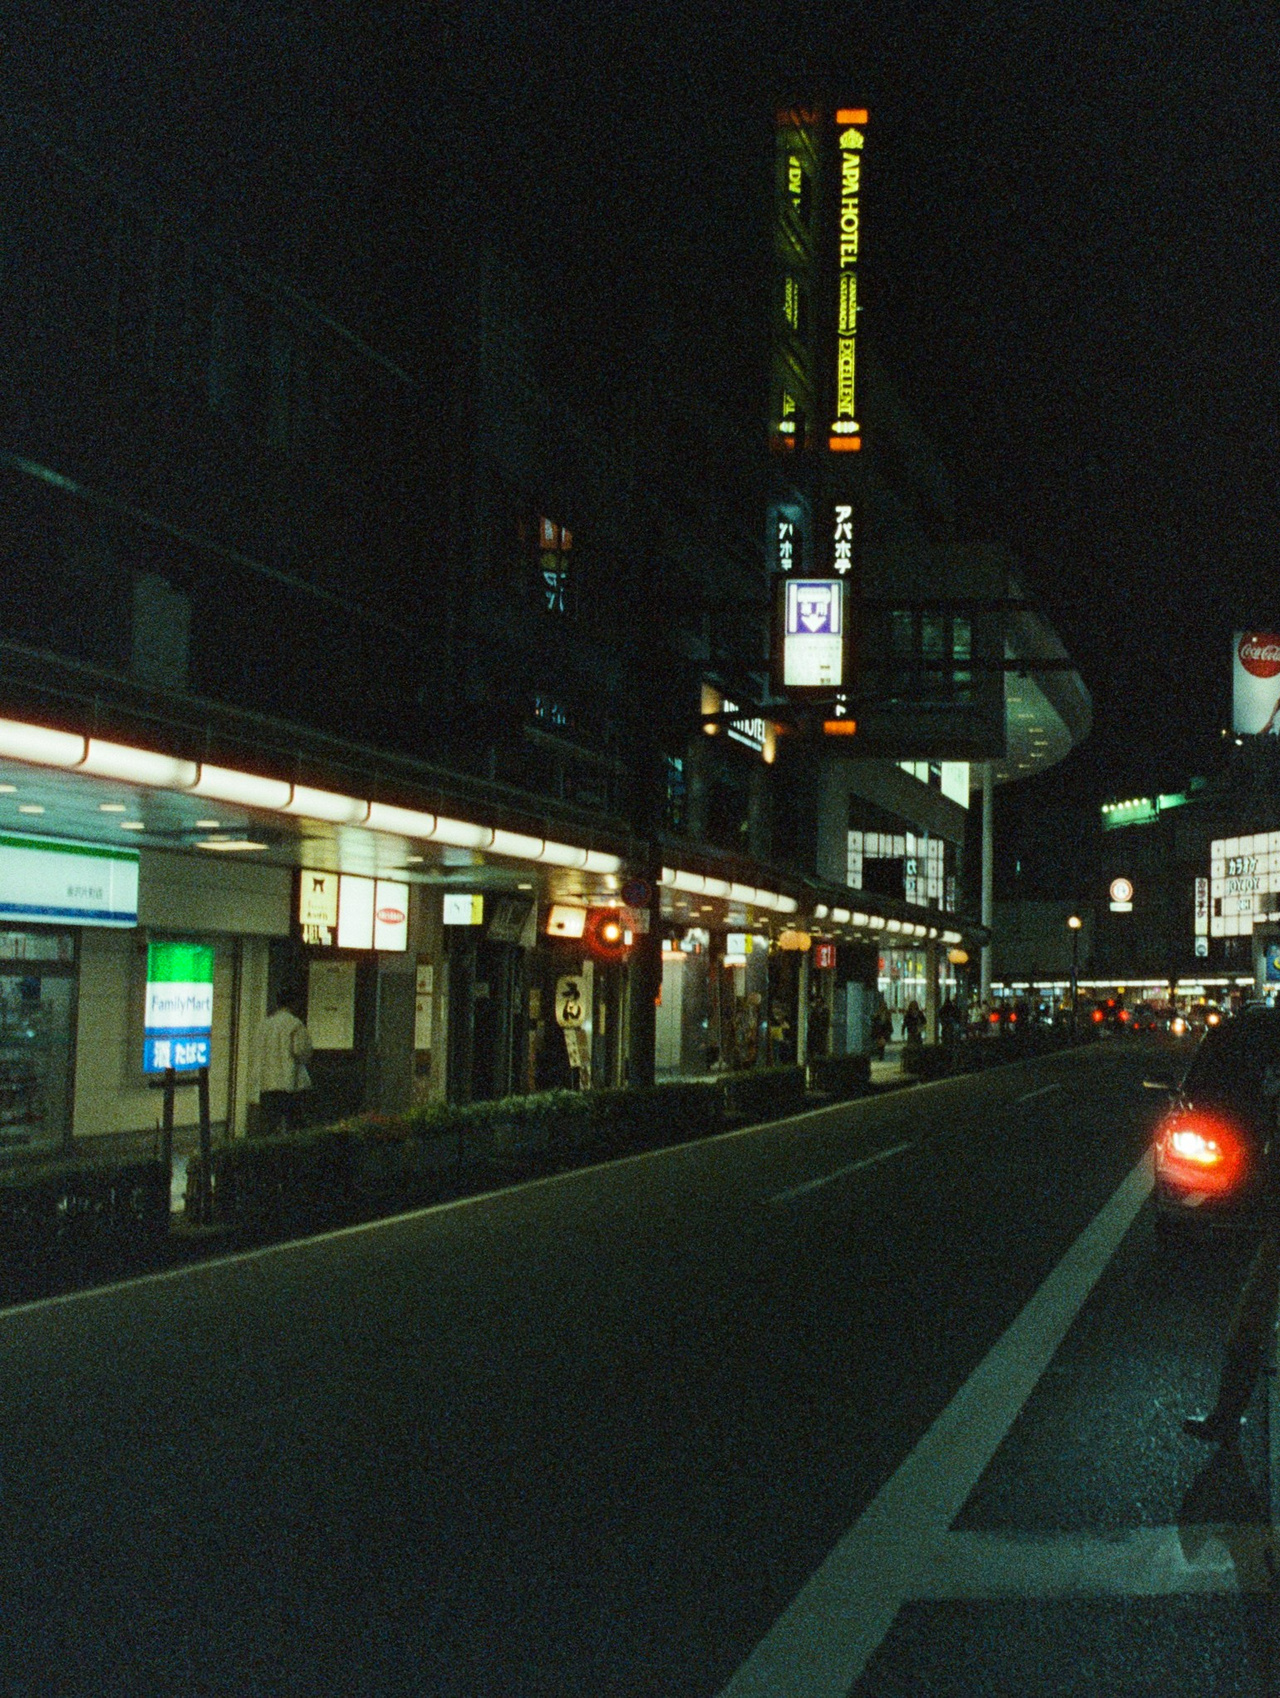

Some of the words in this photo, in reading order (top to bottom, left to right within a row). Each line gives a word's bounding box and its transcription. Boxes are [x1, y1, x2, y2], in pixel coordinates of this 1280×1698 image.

[841, 152, 860, 195] APA
[840, 198, 859, 268] HOTEL
[835, 506, 852, 574] アパホテ
[1229, 858, 1257, 875] カラオケ
[151, 995, 210, 1018] FamilyMart
[175, 1042, 207, 1065] たばこ
